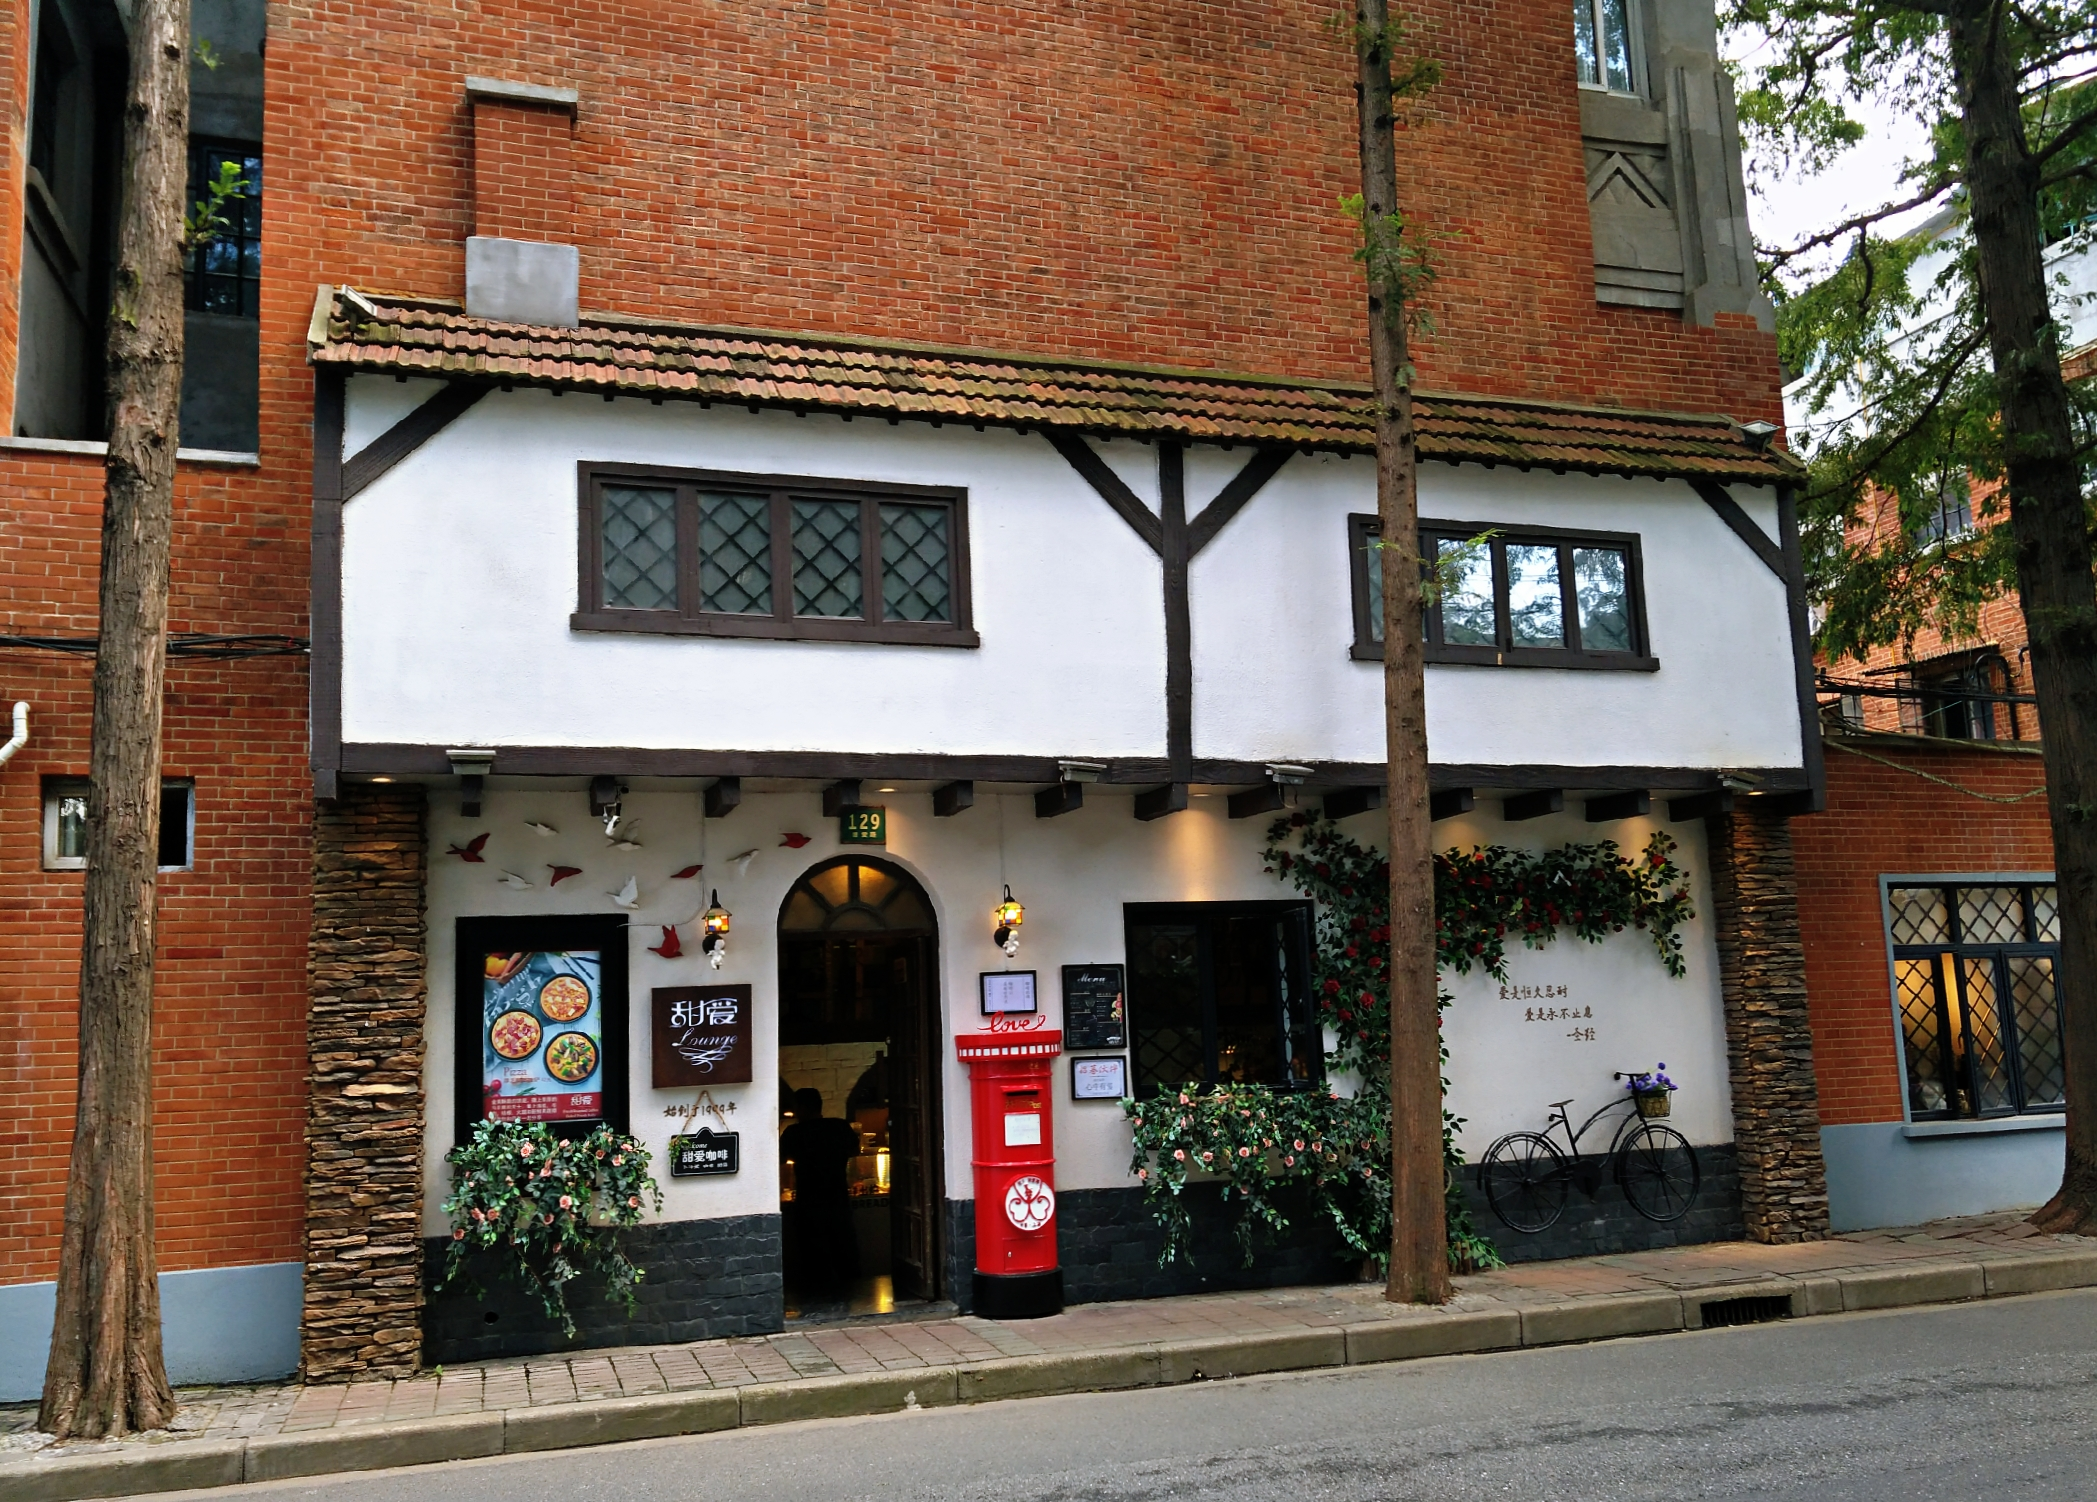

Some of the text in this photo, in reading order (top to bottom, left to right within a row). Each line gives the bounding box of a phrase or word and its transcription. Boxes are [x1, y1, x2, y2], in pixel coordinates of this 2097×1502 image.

[848, 813, 880, 830] 129
[1076, 973, 1106, 983] Menu
[669, 997, 738, 1028] 甜爱
[981, 1010, 1038, 1033] love
[503, 1066, 528, 1077] Pizza
[682, 1149, 729, 1163] 甜爱咖啡
